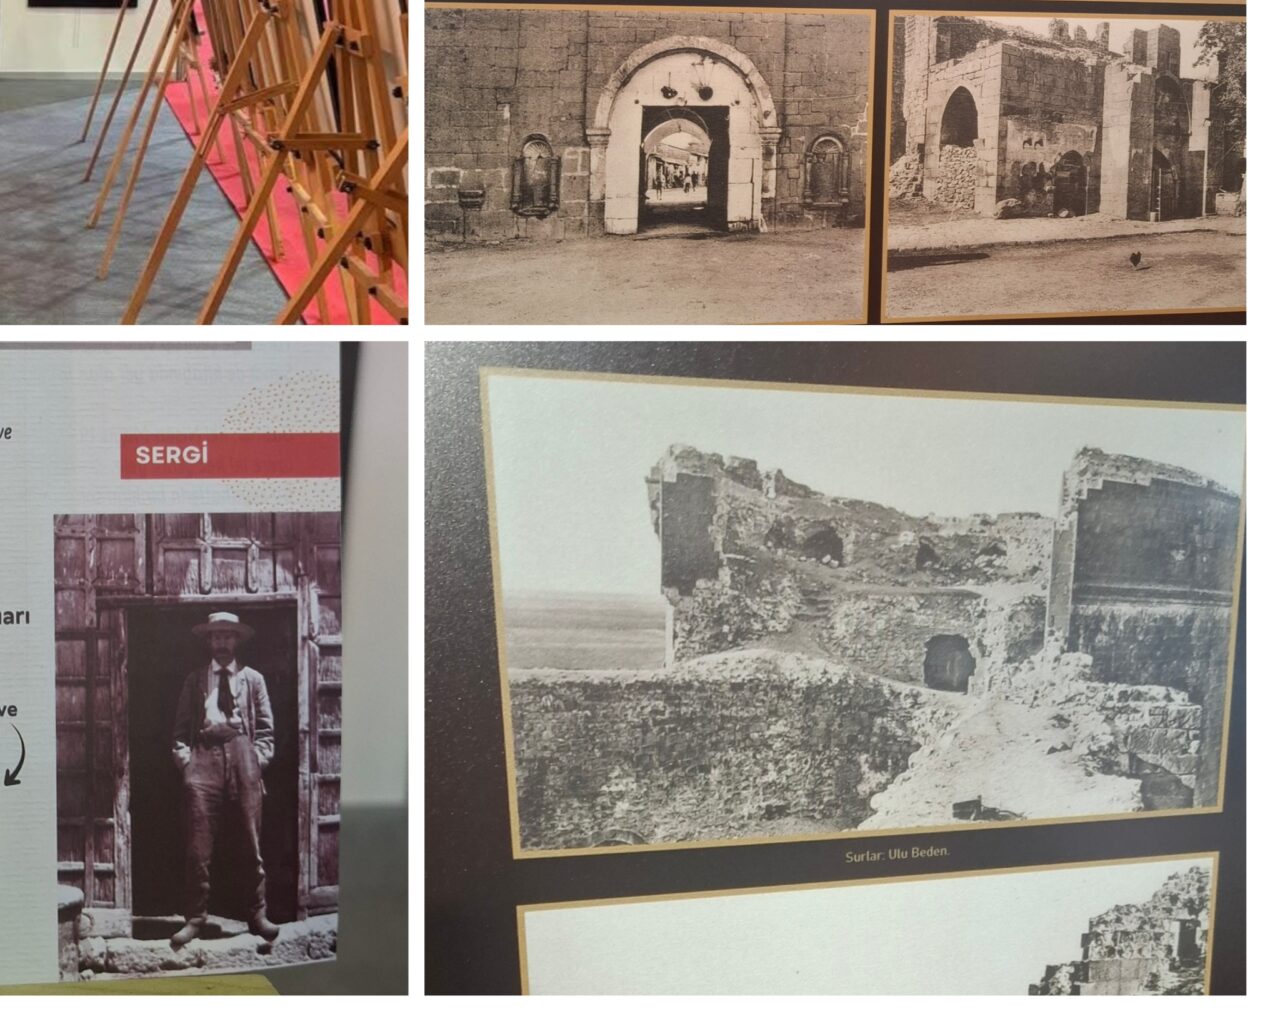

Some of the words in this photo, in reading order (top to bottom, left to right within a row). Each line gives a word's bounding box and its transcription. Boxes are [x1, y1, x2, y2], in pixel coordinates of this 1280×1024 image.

[136, 440, 208, 464] SERGİ
[845, 851, 886, 863] Surlar:
[888, 848, 908, 860] Ulu
[912, 846, 950, 858] Beden.
